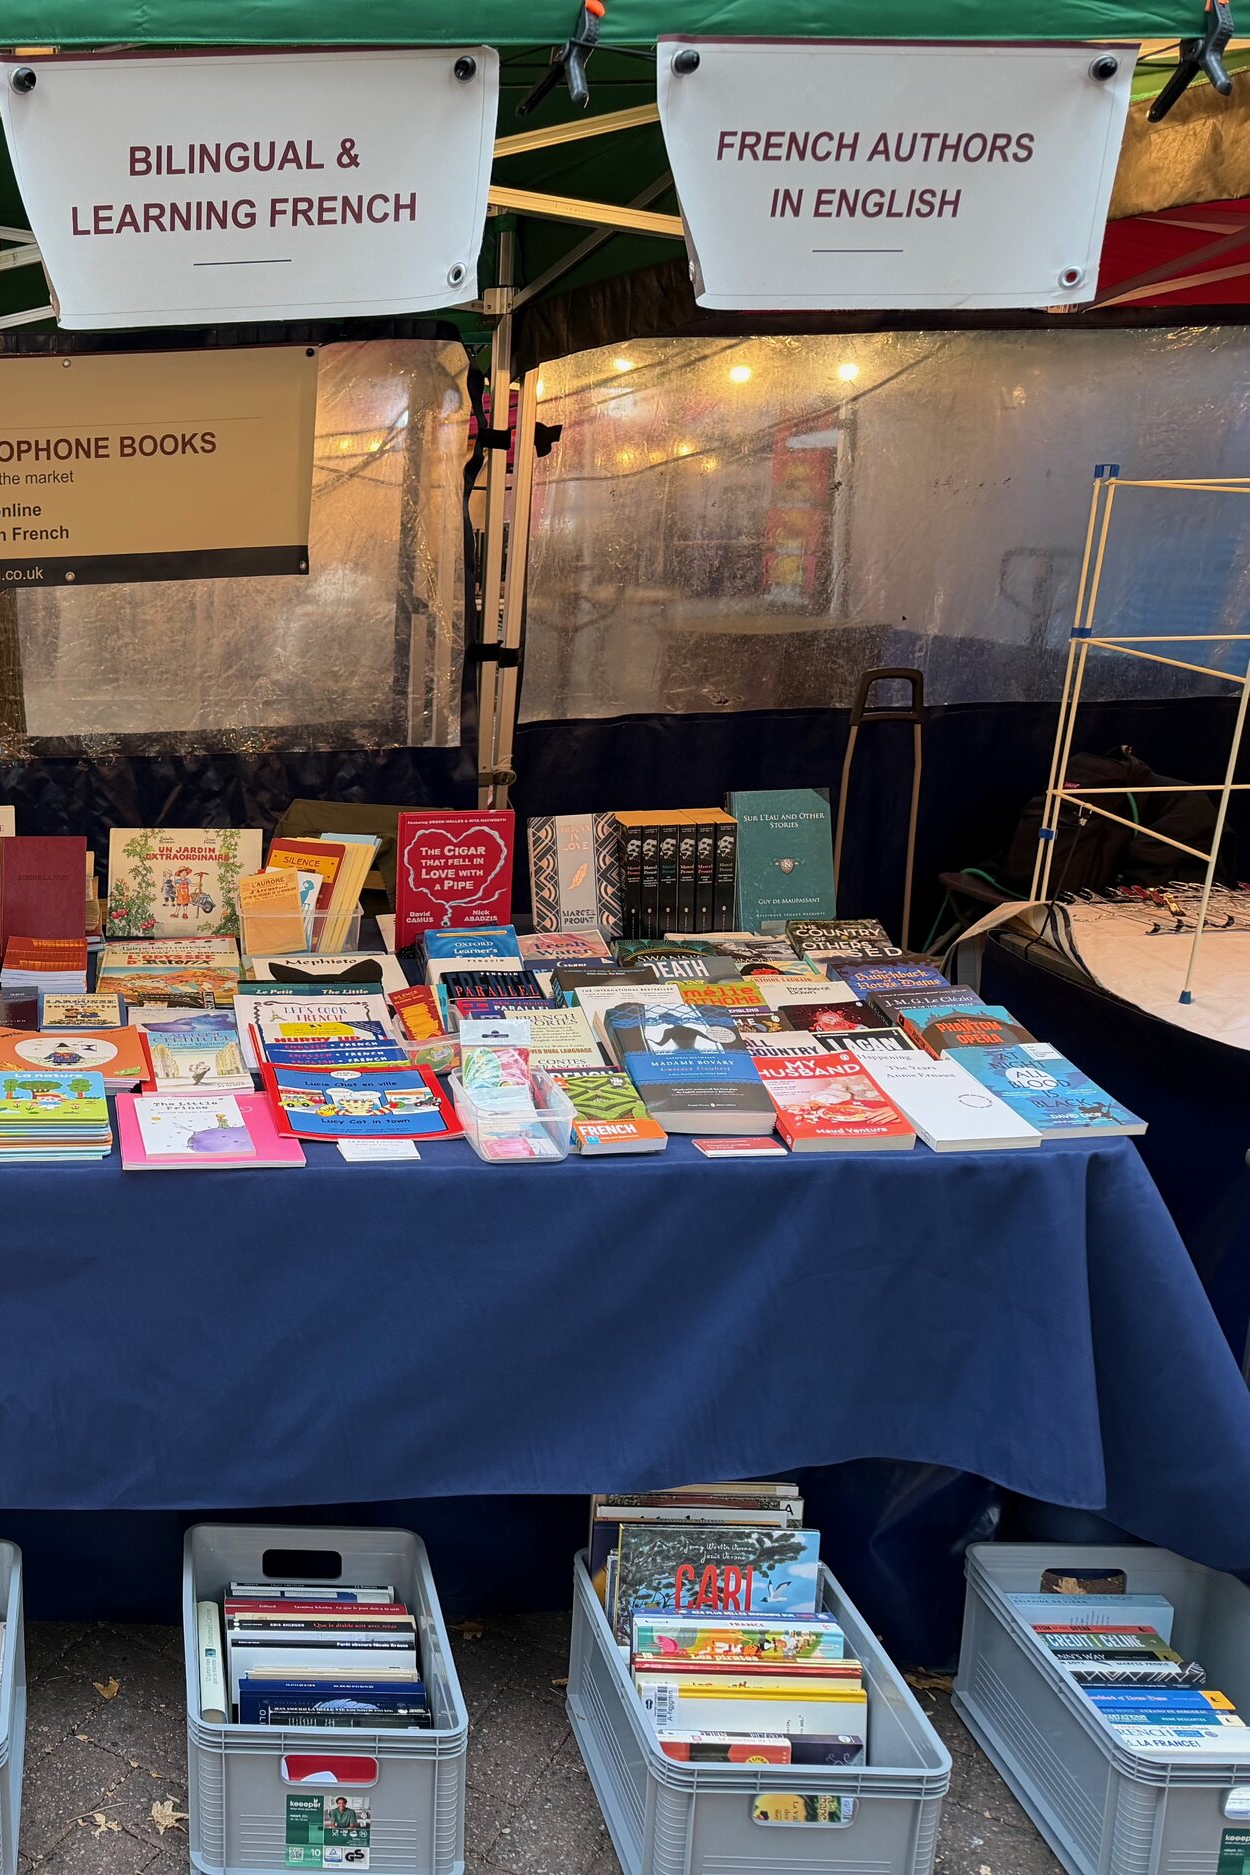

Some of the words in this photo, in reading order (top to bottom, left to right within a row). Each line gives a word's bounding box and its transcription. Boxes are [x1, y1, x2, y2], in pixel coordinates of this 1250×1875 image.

[716, 129, 860, 163] FRENCH
[867, 130, 1036, 163] AUTHORS
[129, 138, 327, 176] BILINGUAL
[335, 138, 360, 169] &
[769, 186, 805, 218] IN
[812, 187, 962, 219] ENGLISH
[70, 196, 259, 237] LEARNING
[269, 191, 418, 230] FRENCH
[118, 431, 218, 458] BOOKS
[25, 470, 74, 485] market
[12, 525, 69, 540] French
[781, 813, 797, 821] AND
[799, 812, 825, 820] OTHER
[770, 821, 799, 829] STORIES
[444, 845, 486, 855] CIGAR
[283, 856, 321, 868] SILENCE
[448, 858, 471, 866] FELL
[421, 868, 456, 879] LOVE
[443, 880, 474, 890] PIPE
[406, 916, 434, 924] CAMUS
[795, 929, 880, 937] COUNTRY
[802, 942, 872, 950] OTHERS
[455, 985, 540, 997] PARALLEL
[935, 1021, 1003, 1033] PHANTOM
[956, 1034, 1005, 1044] OPERA
[998, 1052, 1019, 1060] AT
[758, 1064, 860, 1078] HUSBAND
[784, 1060, 816, 1071] MY
[1016, 1070, 1048, 1078] ALL
[1007, 1079, 1071, 1089] BLOOD
[579, 1124, 638, 1136] FRENCH
